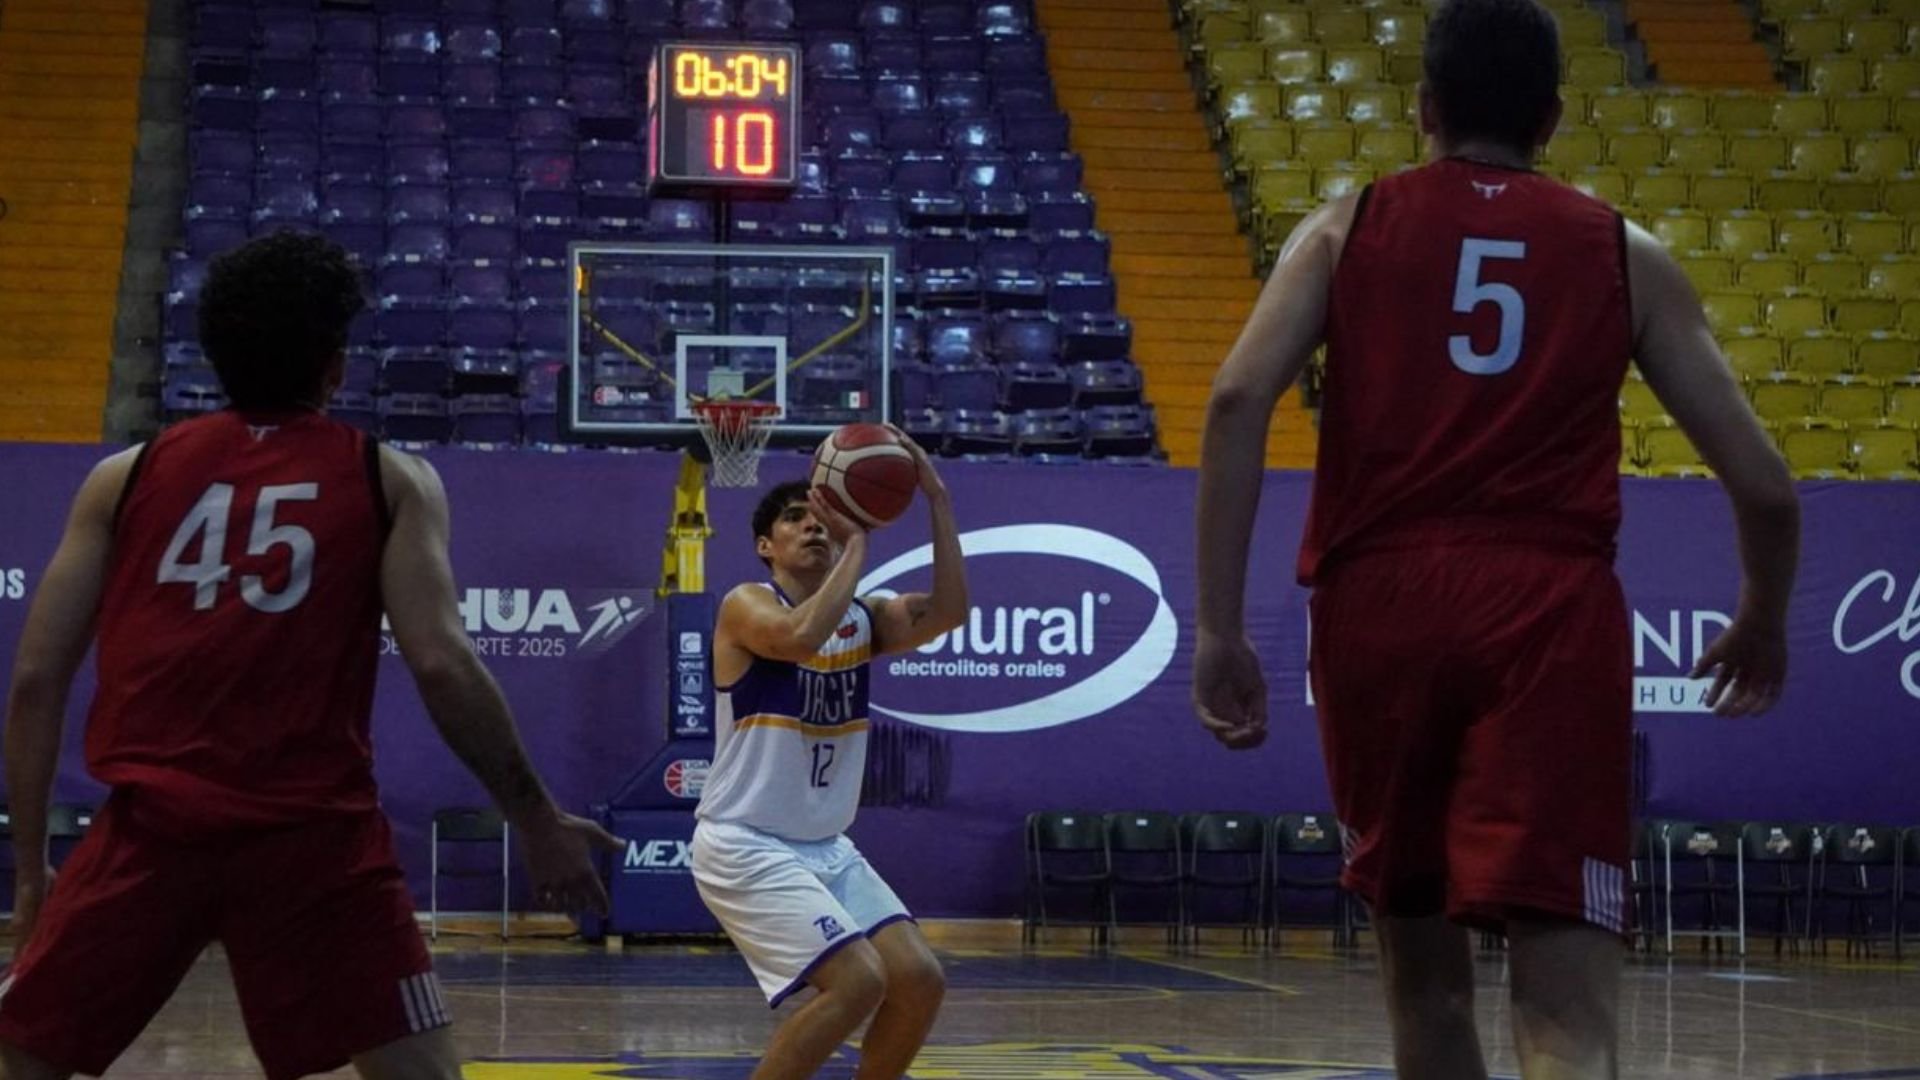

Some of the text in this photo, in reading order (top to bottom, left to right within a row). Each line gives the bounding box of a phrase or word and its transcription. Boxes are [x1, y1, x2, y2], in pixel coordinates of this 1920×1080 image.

[676, 52, 787, 97] 06:04
[714, 113, 773, 174] 10
[1449, 238, 1526, 375] 5
[157, 482, 319, 613] 45
[518, 638, 567, 657] 2025
[889, 658, 1066, 678] electrolitos orales
[811, 743, 835, 788] 12
